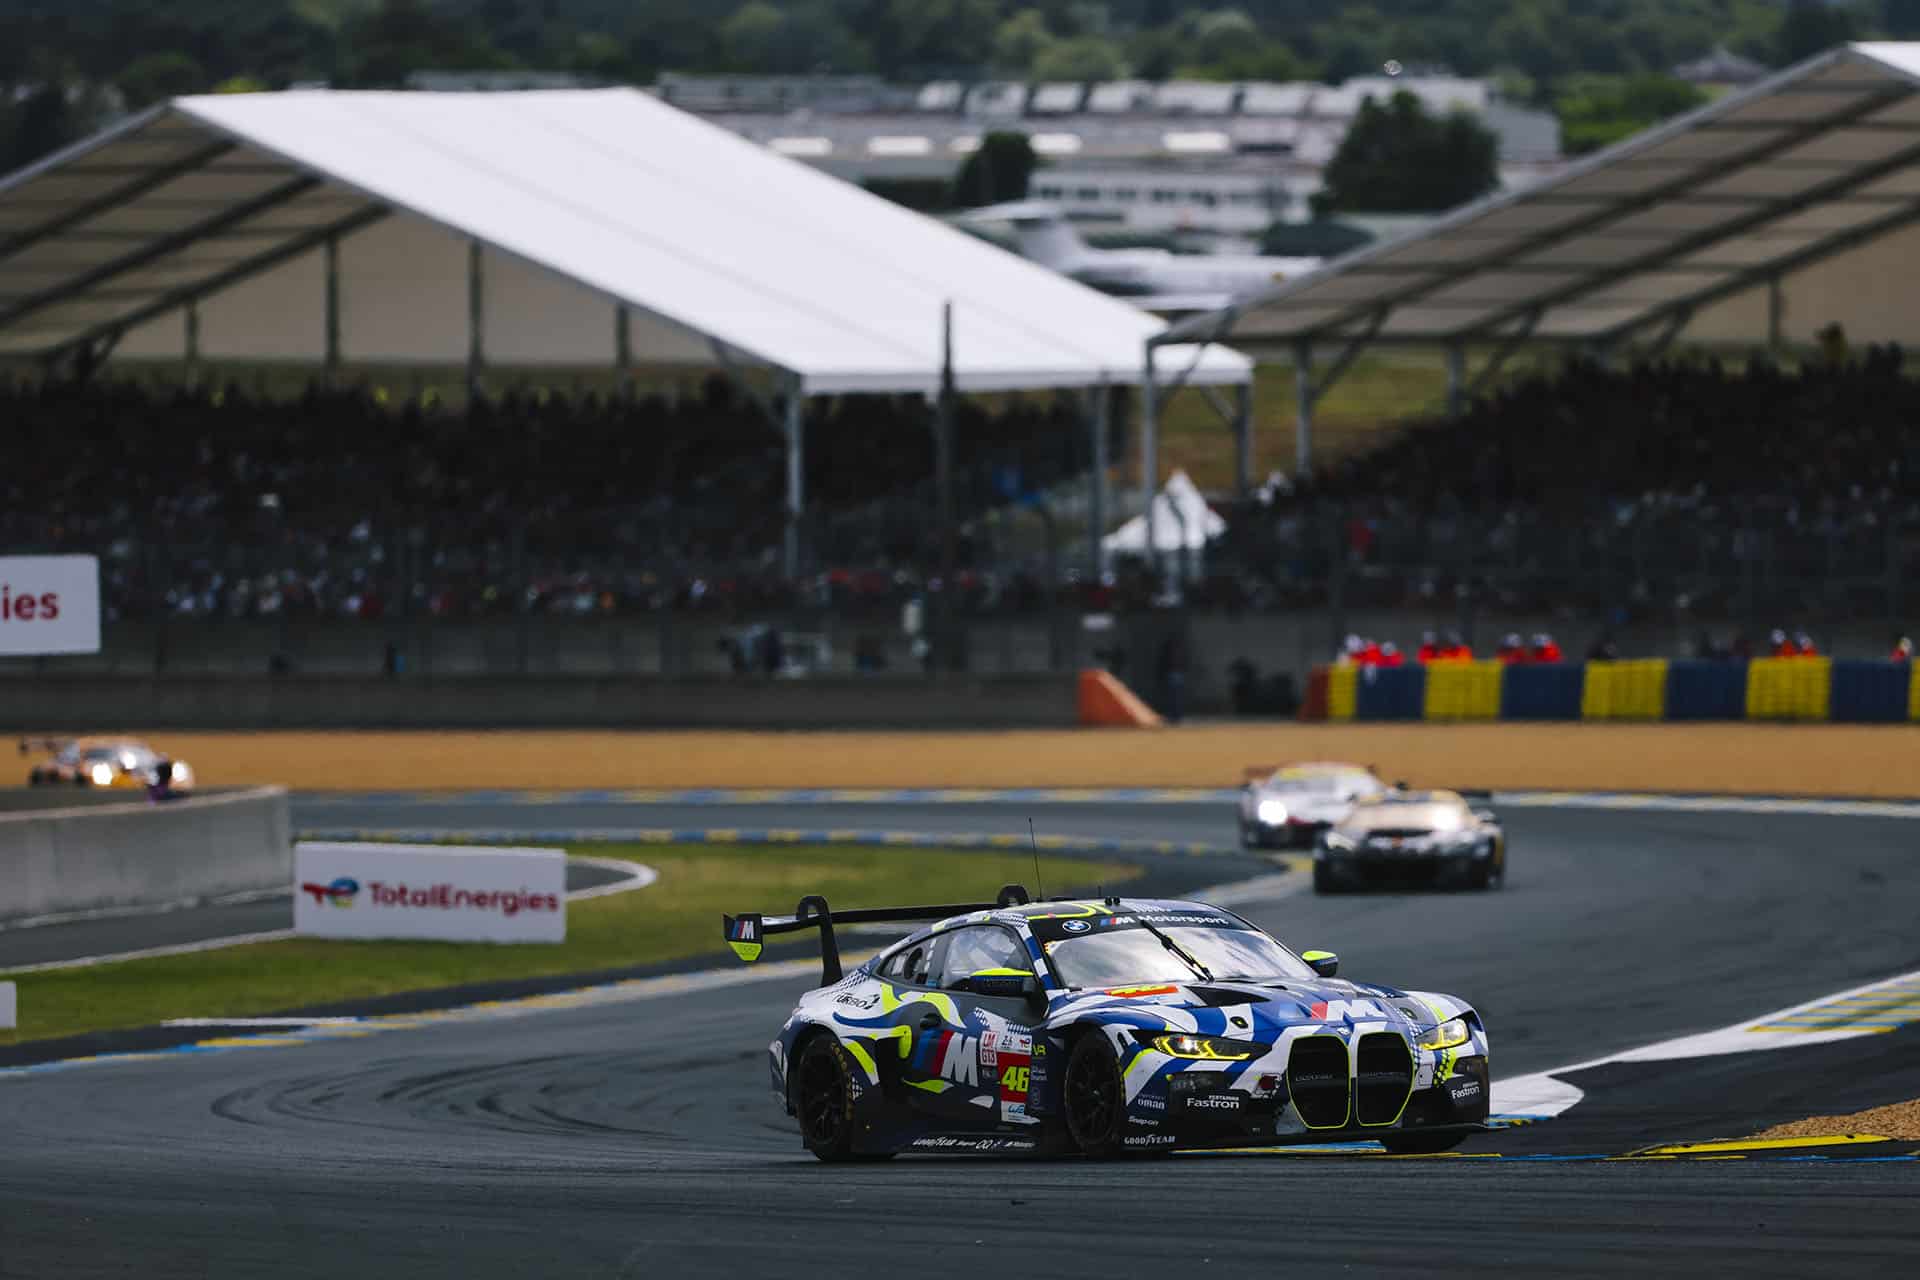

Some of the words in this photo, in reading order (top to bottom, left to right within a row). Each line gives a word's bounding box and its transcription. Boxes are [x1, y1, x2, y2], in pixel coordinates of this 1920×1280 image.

[2, 585, 60, 621] ies
[367, 881, 558, 917] TotalEnergies
[1138, 915, 1229, 926] Motorsport
[941, 1031, 979, 1088] M
[1001, 1066, 1030, 1092] 46
[1451, 1086, 1480, 1100] Fastron
[1137, 1098, 1165, 1110] oman
[1187, 1098, 1240, 1109] Fastron
[1124, 1134, 1176, 1146] GOODYEAR
